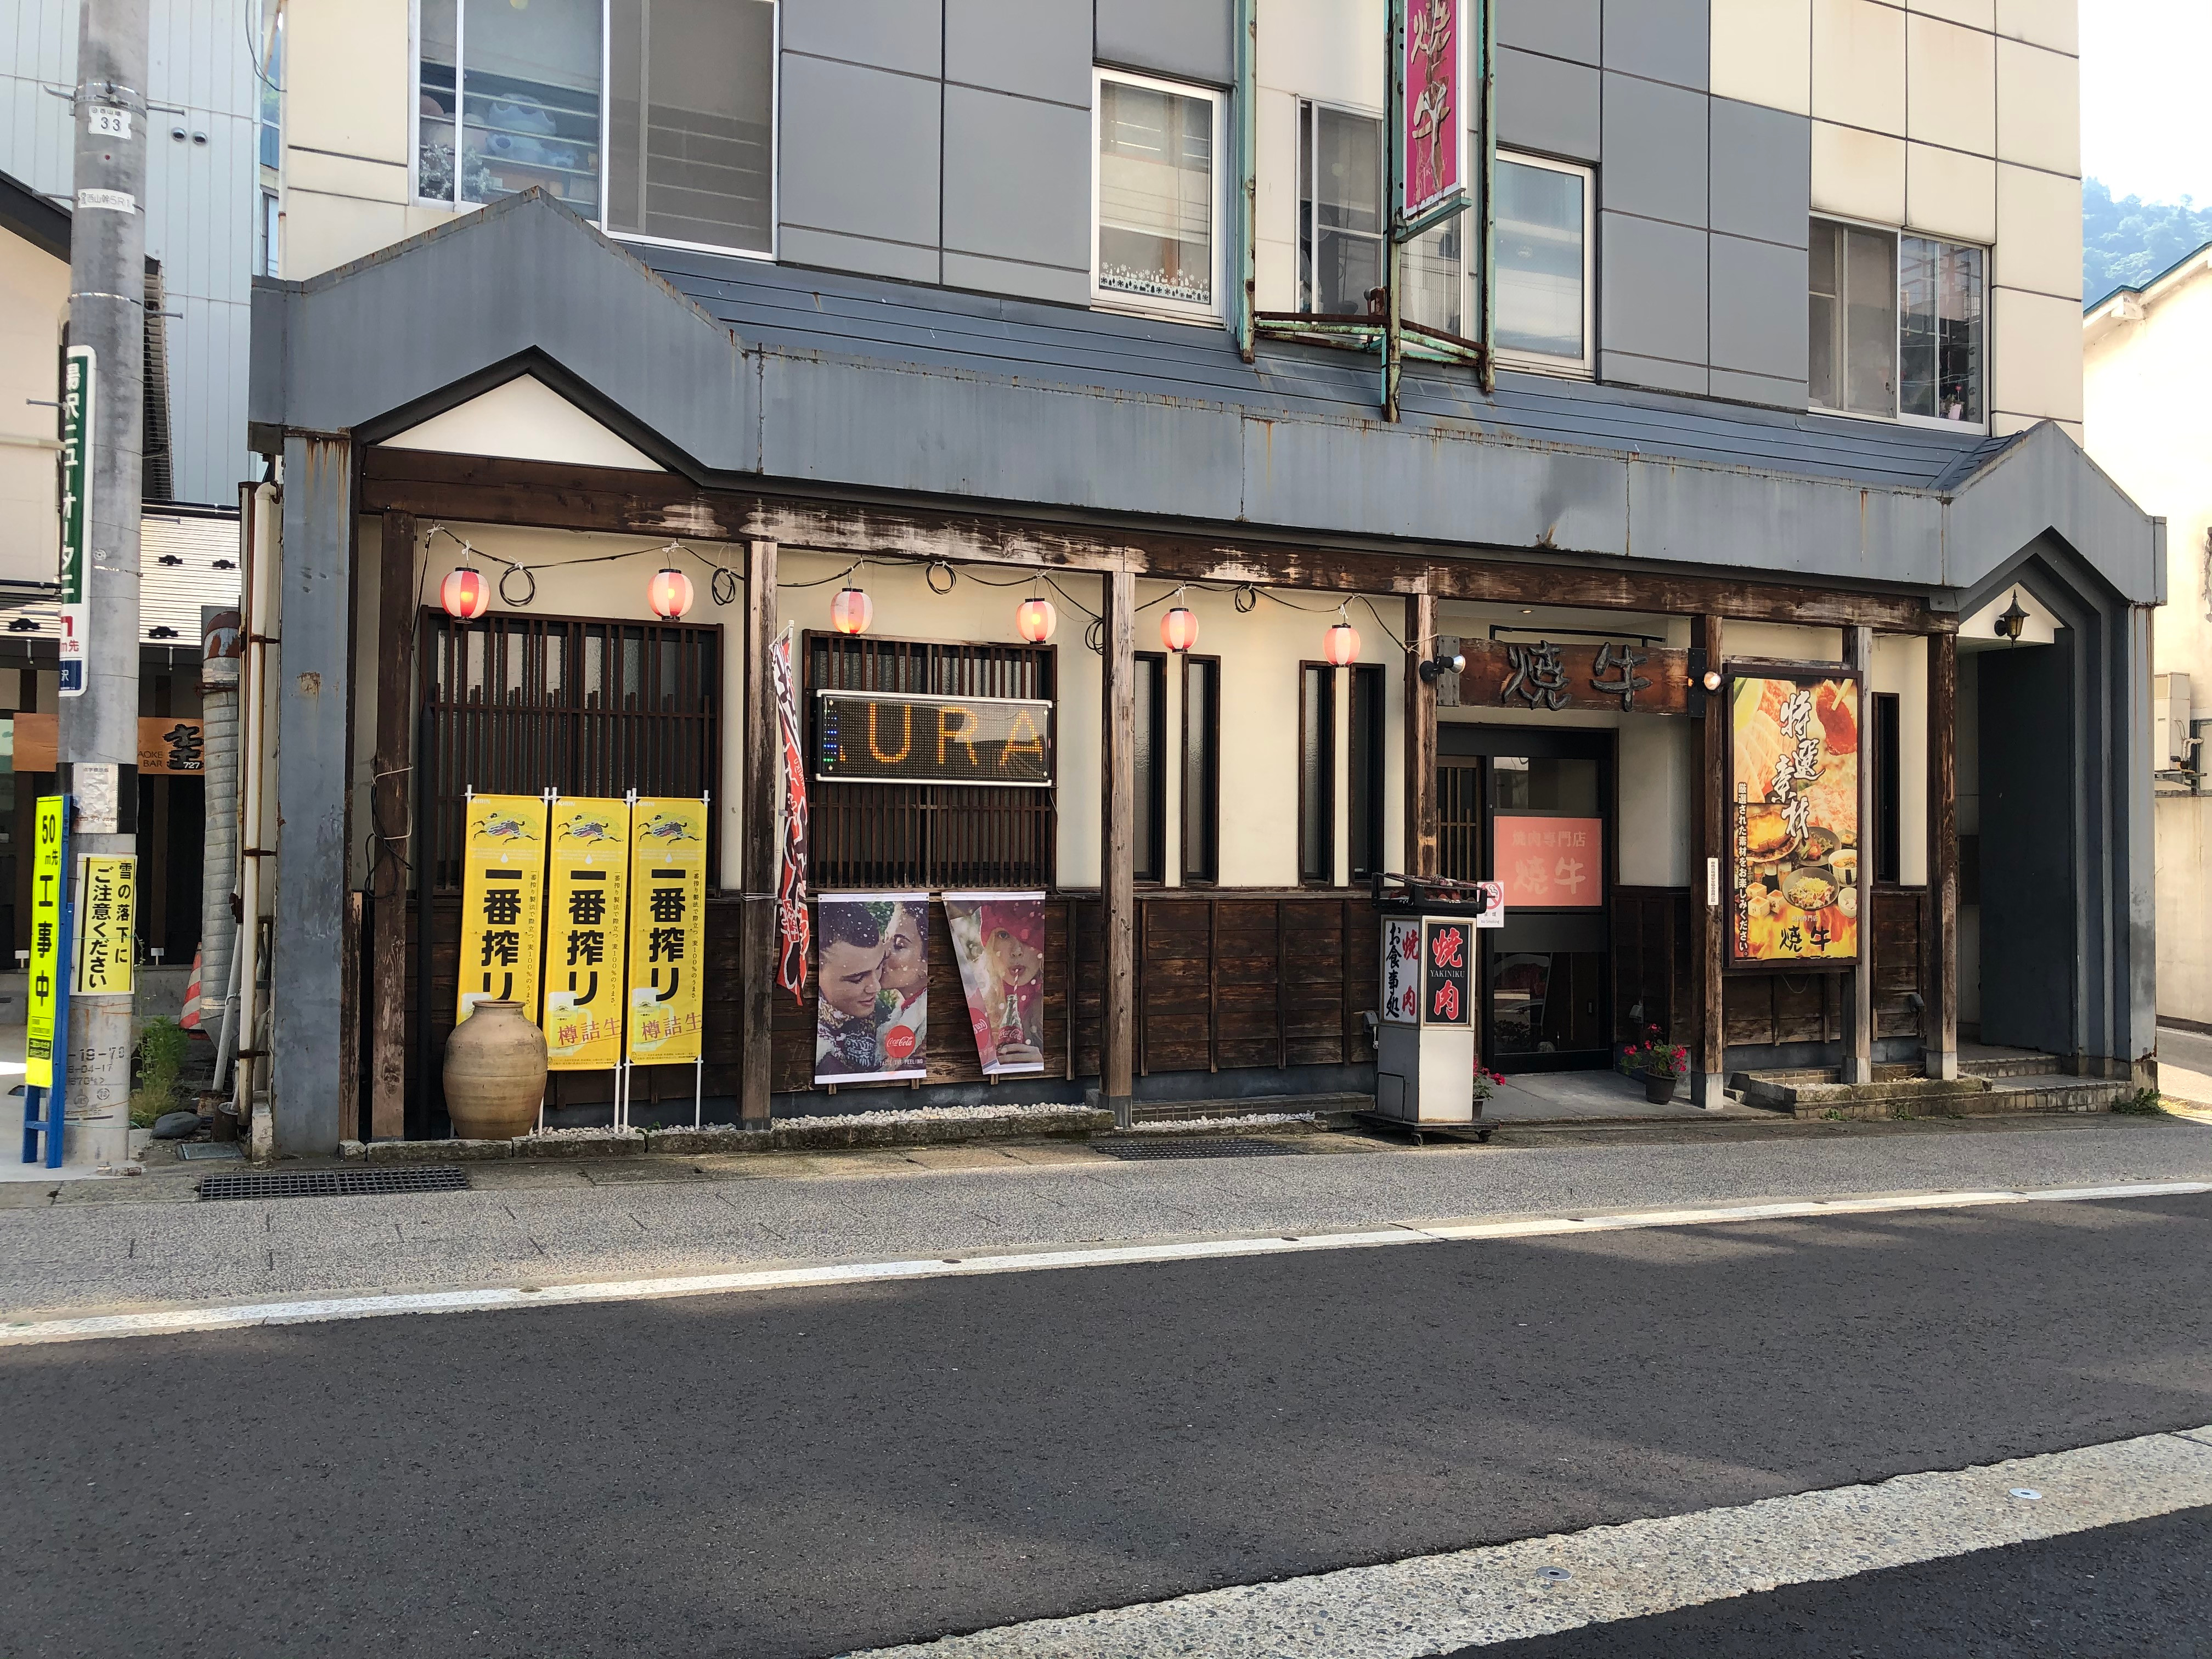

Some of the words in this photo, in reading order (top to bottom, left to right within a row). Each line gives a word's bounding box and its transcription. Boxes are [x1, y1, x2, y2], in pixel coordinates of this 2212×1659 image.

[100, 116, 121, 132] 33
[1503, 640, 1652, 712] 焼牛
[42, 814, 55, 844] 50
[36, 875, 53, 1007] 工事中
[89, 866, 114, 988] ご注意ください
[115, 863, 132, 964] 雪の落下に
[567, 870, 607, 1006] 一番搾り
[649, 868, 686, 1002] 一番搾り
[1779, 925, 1831, 952] 焼牛
[1386, 922, 1402, 1018] お食事処
[1402, 929, 1419, 1017] 焼肉
[1430, 969, 1465, 978] YAKINIKU
[557, 1017, 621, 1046] 樽詰生
[641, 1012, 702, 1041] 樽詰生
